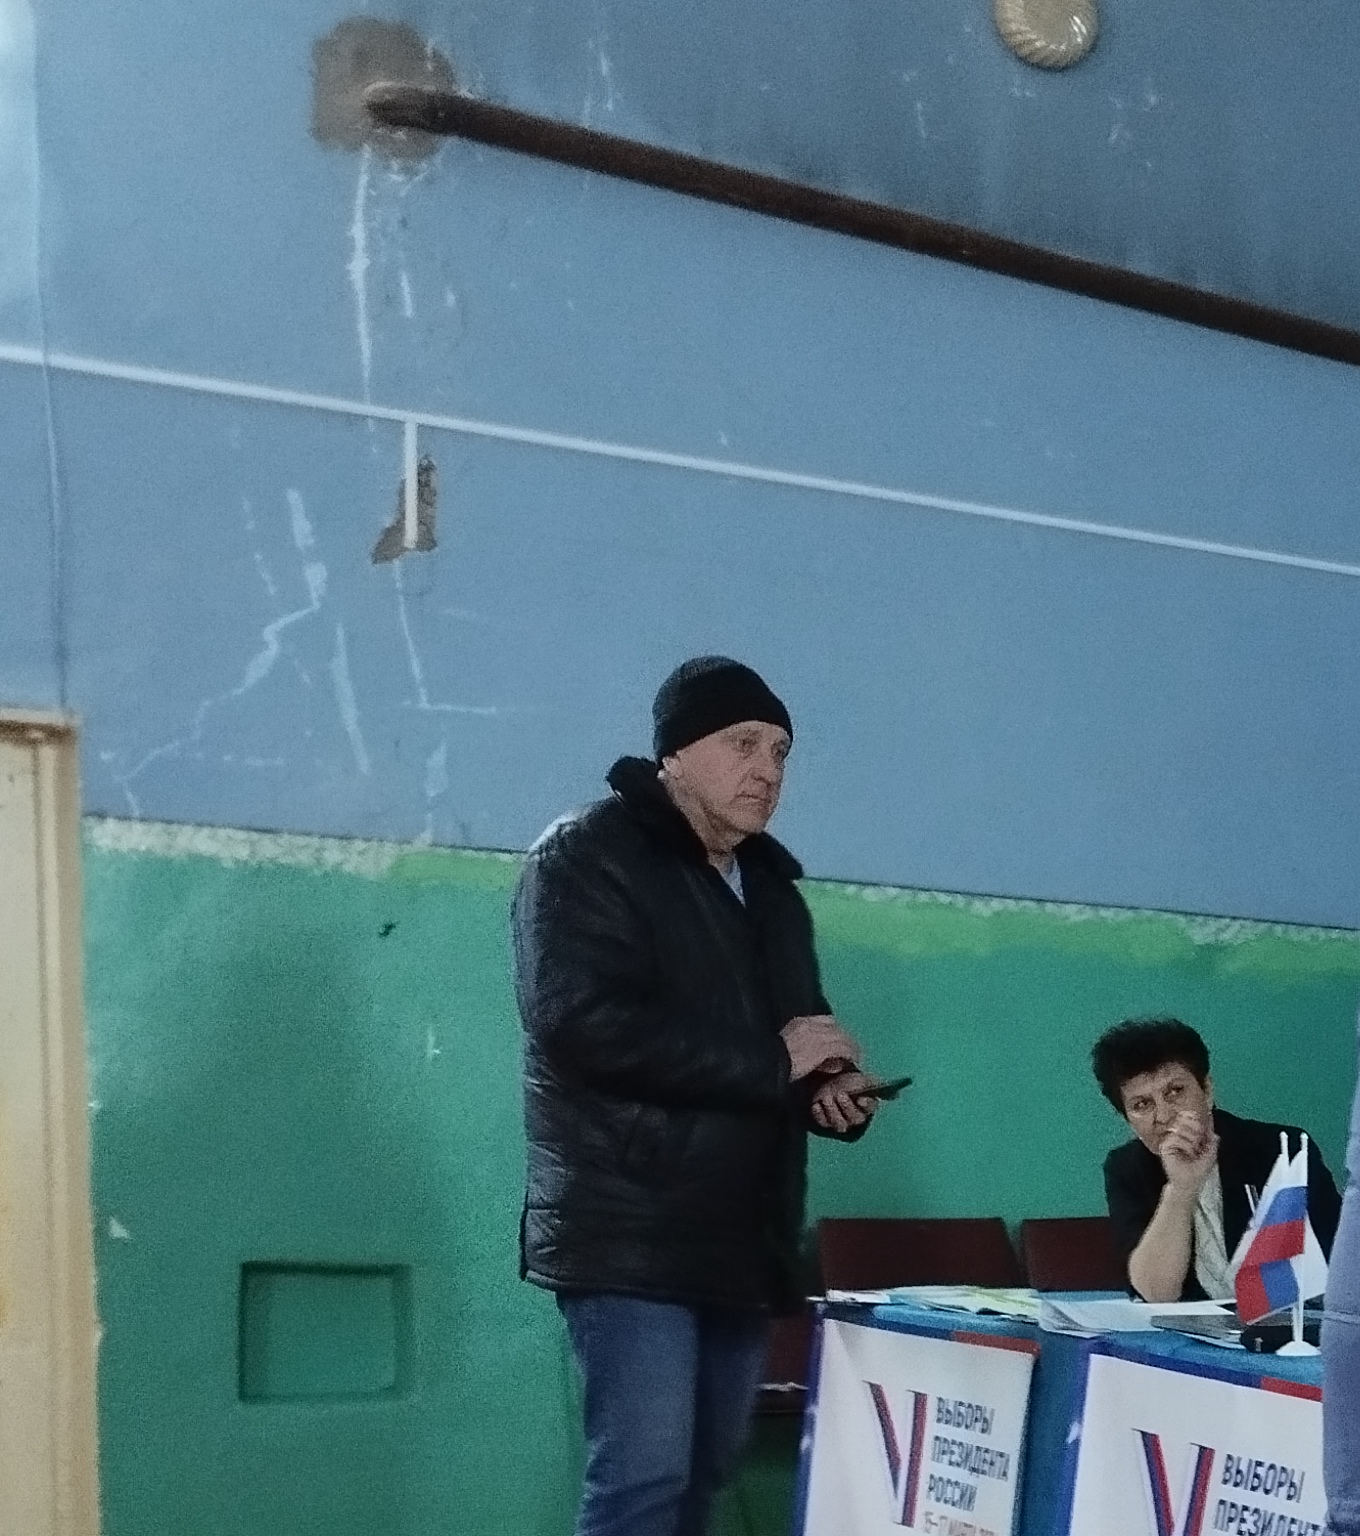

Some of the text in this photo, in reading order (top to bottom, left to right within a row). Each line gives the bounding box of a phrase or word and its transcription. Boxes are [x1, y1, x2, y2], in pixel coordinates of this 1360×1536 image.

[936, 1396, 995, 1435] ВЫБОРЫ
[931, 1435, 1010, 1482] ПРЕЗИДЕНТА
[1221, 1454, 1305, 1503] ВЫБОРЫ
[926, 1473, 977, 1512] РОССИИ
